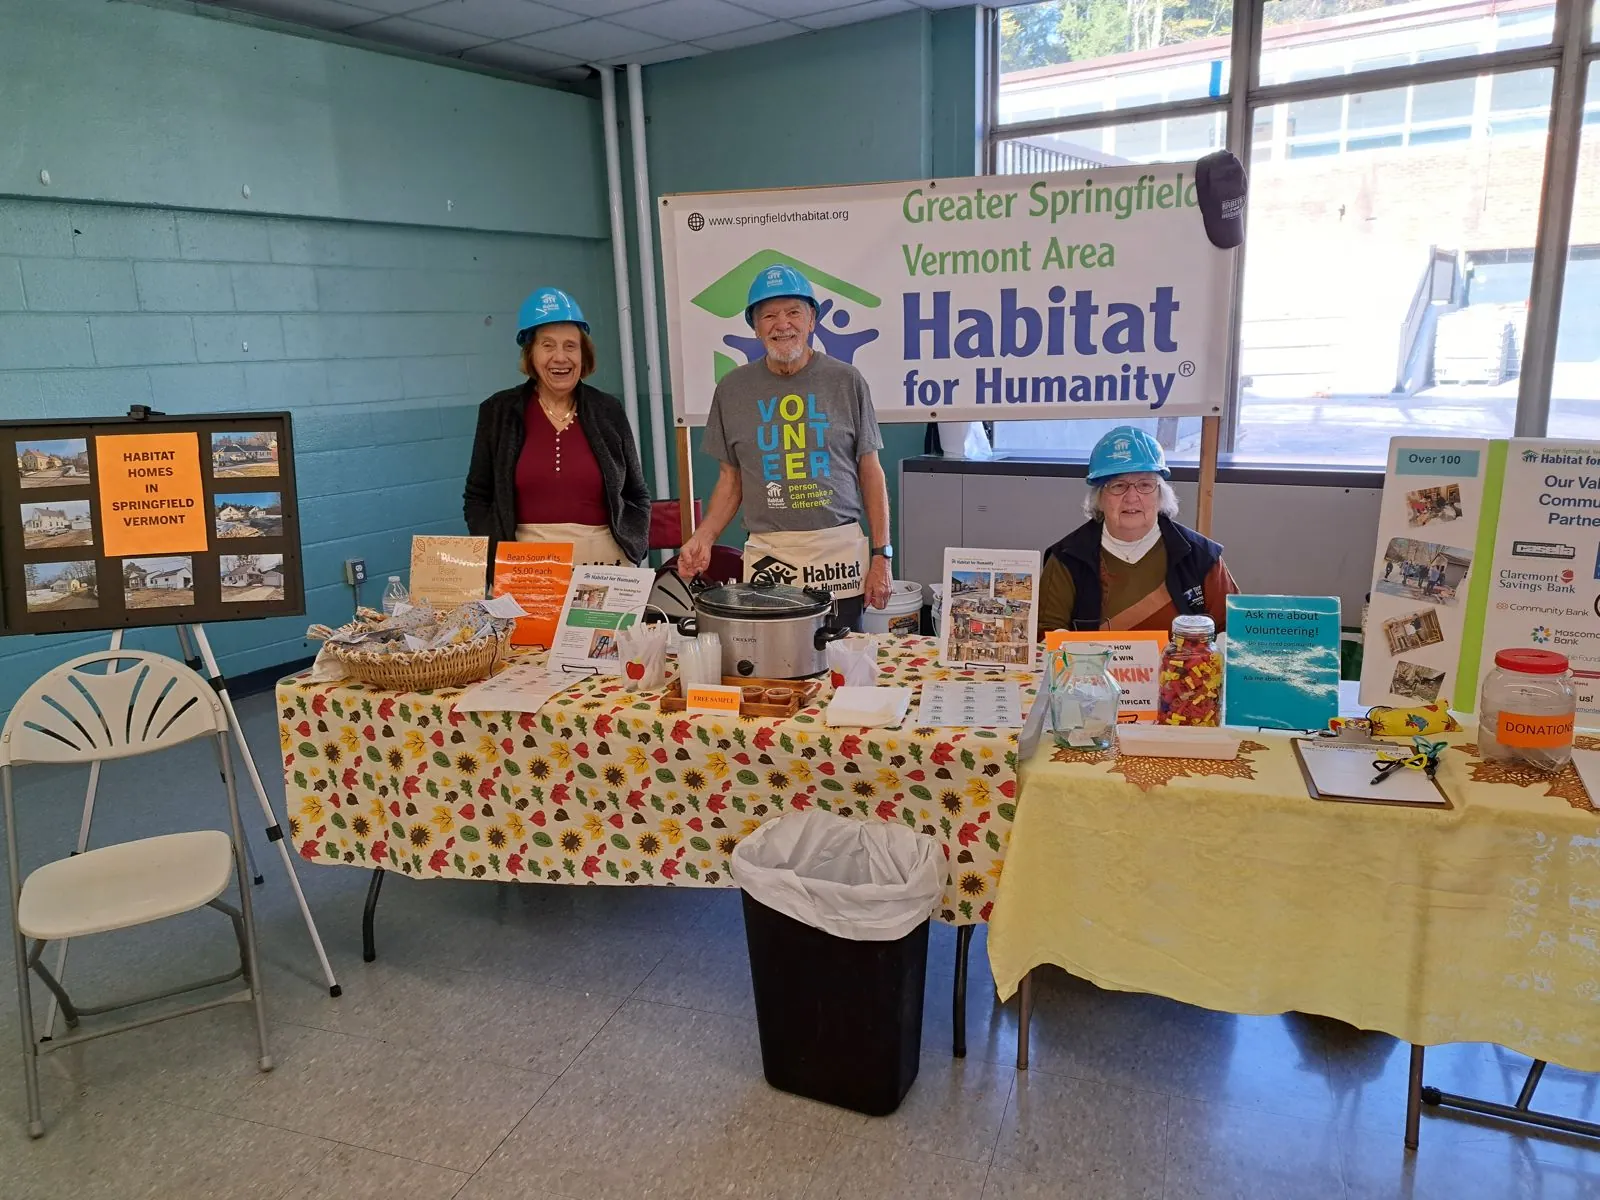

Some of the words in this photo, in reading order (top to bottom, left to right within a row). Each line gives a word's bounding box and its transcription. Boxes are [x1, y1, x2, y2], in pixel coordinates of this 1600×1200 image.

[902, 187, 1017, 224] Greater
[708, 208, 849, 227] www.springfieldvthabitat.org
[902, 241, 1032, 277] Vermont
[1041, 236, 1116, 270] Area
[902, 285, 1180, 361] Habitat
[903, 368, 960, 407] for
[123, 450, 176, 463] HABITAT
[1408, 453, 1437, 465] Over
[1441, 455, 1462, 465] 100
[1540, 453, 1583, 465] Habitat
[127, 466, 174, 479] HOMES
[1544, 474, 1575, 488] Our
[145, 483, 159, 494] IN
[788, 483, 818, 493] person
[807, 489, 828, 499] make
[112, 497, 195, 512] SPRINGFIELD
[123, 514, 186, 527] VERMONT
[1548, 512, 1600, 527] Partne
[507, 553, 525, 561] Bean
[547, 553, 561, 562] Kits
[512, 566, 534, 575] $5.00
[534, 567, 553, 575] each
[802, 560, 861, 583] Habitat
[1499, 569, 1559, 582] Claremont
[821, 579, 861, 592] Humanity
[1499, 579, 1542, 593] Savings
[1547, 582, 1576, 594] Bank
[1244, 610, 1265, 619] Ask
[1267, 611, 1285, 619] me
[1286, 610, 1319, 621] about
[1509, 603, 1565, 617] Community
[1566, 608, 1590, 617] Bank
[1244, 625, 1319, 638] Volunteering!
[1553, 636, 1579, 645] Bank
[1578, 695, 1594, 703] us!
